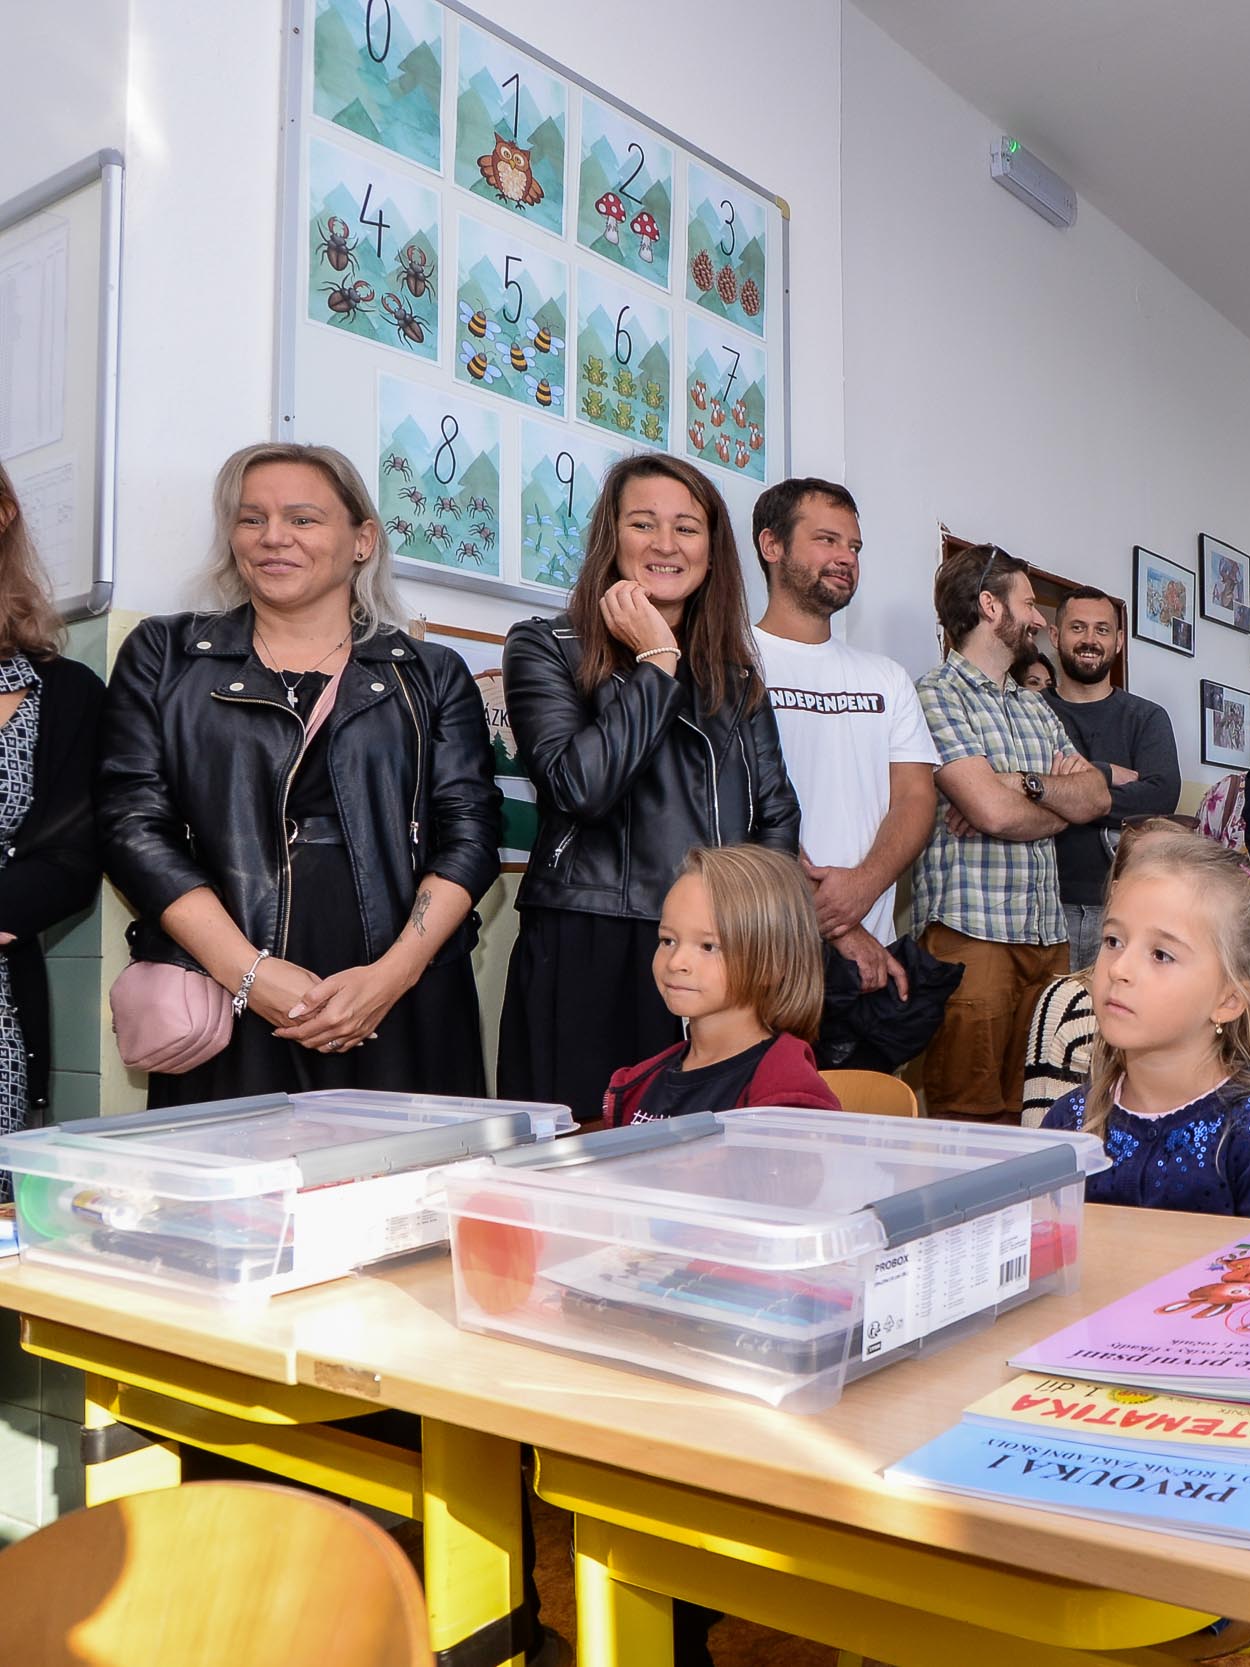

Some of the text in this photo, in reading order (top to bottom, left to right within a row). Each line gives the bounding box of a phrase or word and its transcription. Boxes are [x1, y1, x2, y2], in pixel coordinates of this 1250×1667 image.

[366, 0, 391, 63] 0
[501, 73, 521, 139] 1
[619, 143, 646, 205] 2
[359, 183, 391, 258] 4
[720, 199, 736, 256] 3
[502, 255, 523, 324] 5
[614, 305, 633, 365] 6
[721, 345, 740, 402] 7
[433, 414, 458, 486] 8
[555, 451, 574, 518] 9
[484, 702, 510, 728] ÁZK
[769, 689, 879, 712] NDEPENDENT
[874, 1254, 910, 1273] PROBOX
[1065, 1349, 1147, 1363] psaní
[1149, 1356, 1231, 1368] první
[1170, 1339, 1219, 1348] ročník
[1034, 1379, 1105, 1399] 1. díl
[981, 1438, 1040, 1456] ŠKOLY
[1039, 1448, 1138, 1470] ZÁKLADNÍ
[1020, 1459, 1239, 1504] PRVOUKA
[1142, 1463, 1217, 1480] ROČNÍK
